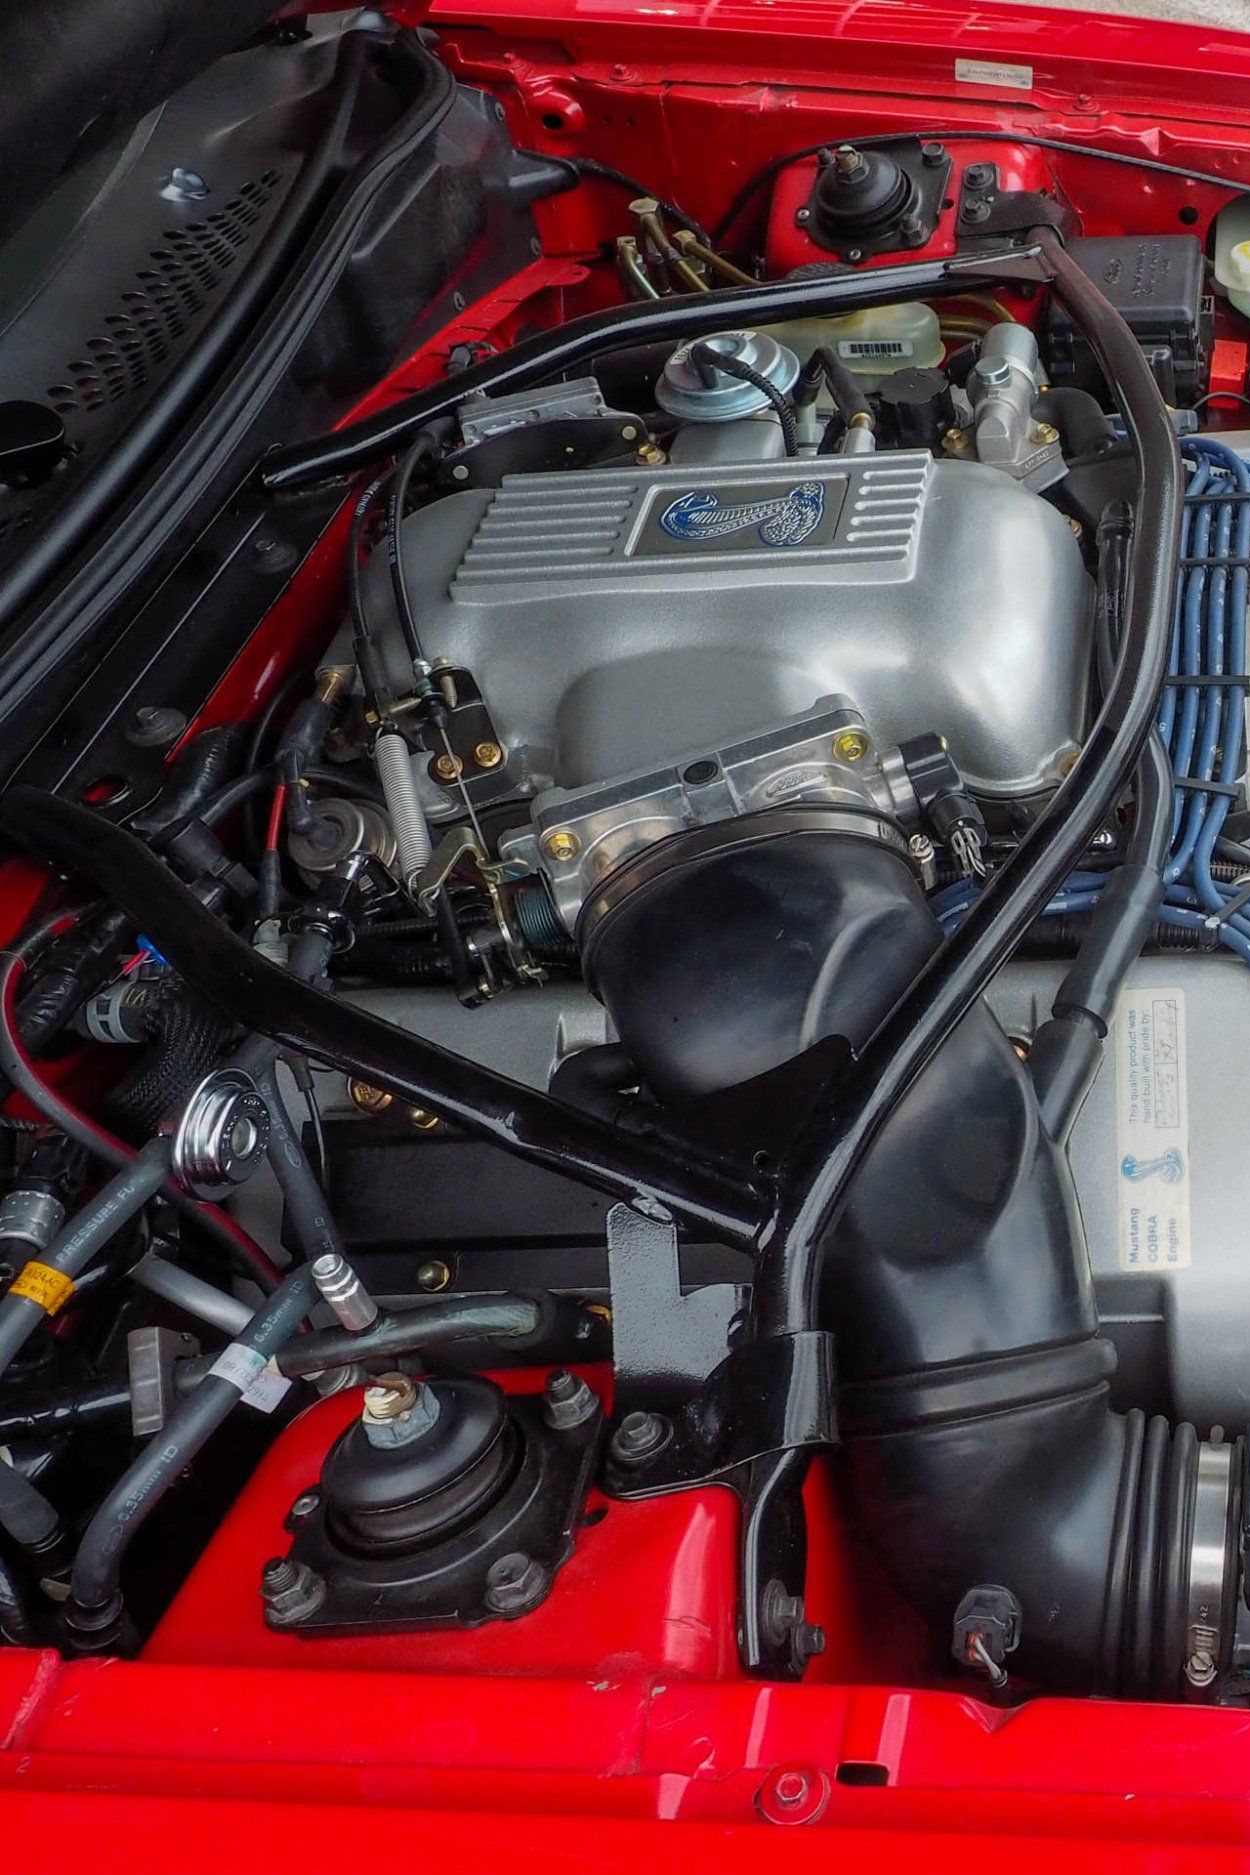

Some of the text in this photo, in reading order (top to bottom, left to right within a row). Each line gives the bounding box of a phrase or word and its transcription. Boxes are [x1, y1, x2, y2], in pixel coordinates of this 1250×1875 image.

[1127, 1009, 1139, 1123] This quality product was
[1142, 1053, 1150, 1073] with
[55, 1201, 119, 1262] PRESSURE
[1129, 1208, 1142, 1264] Mustang
[1148, 1215, 1159, 1263] COBRA
[1167, 1218, 1180, 1263] Engine
[253, 1299, 292, 1343] 6.35mm
[160, 1445, 178, 1463] ID
